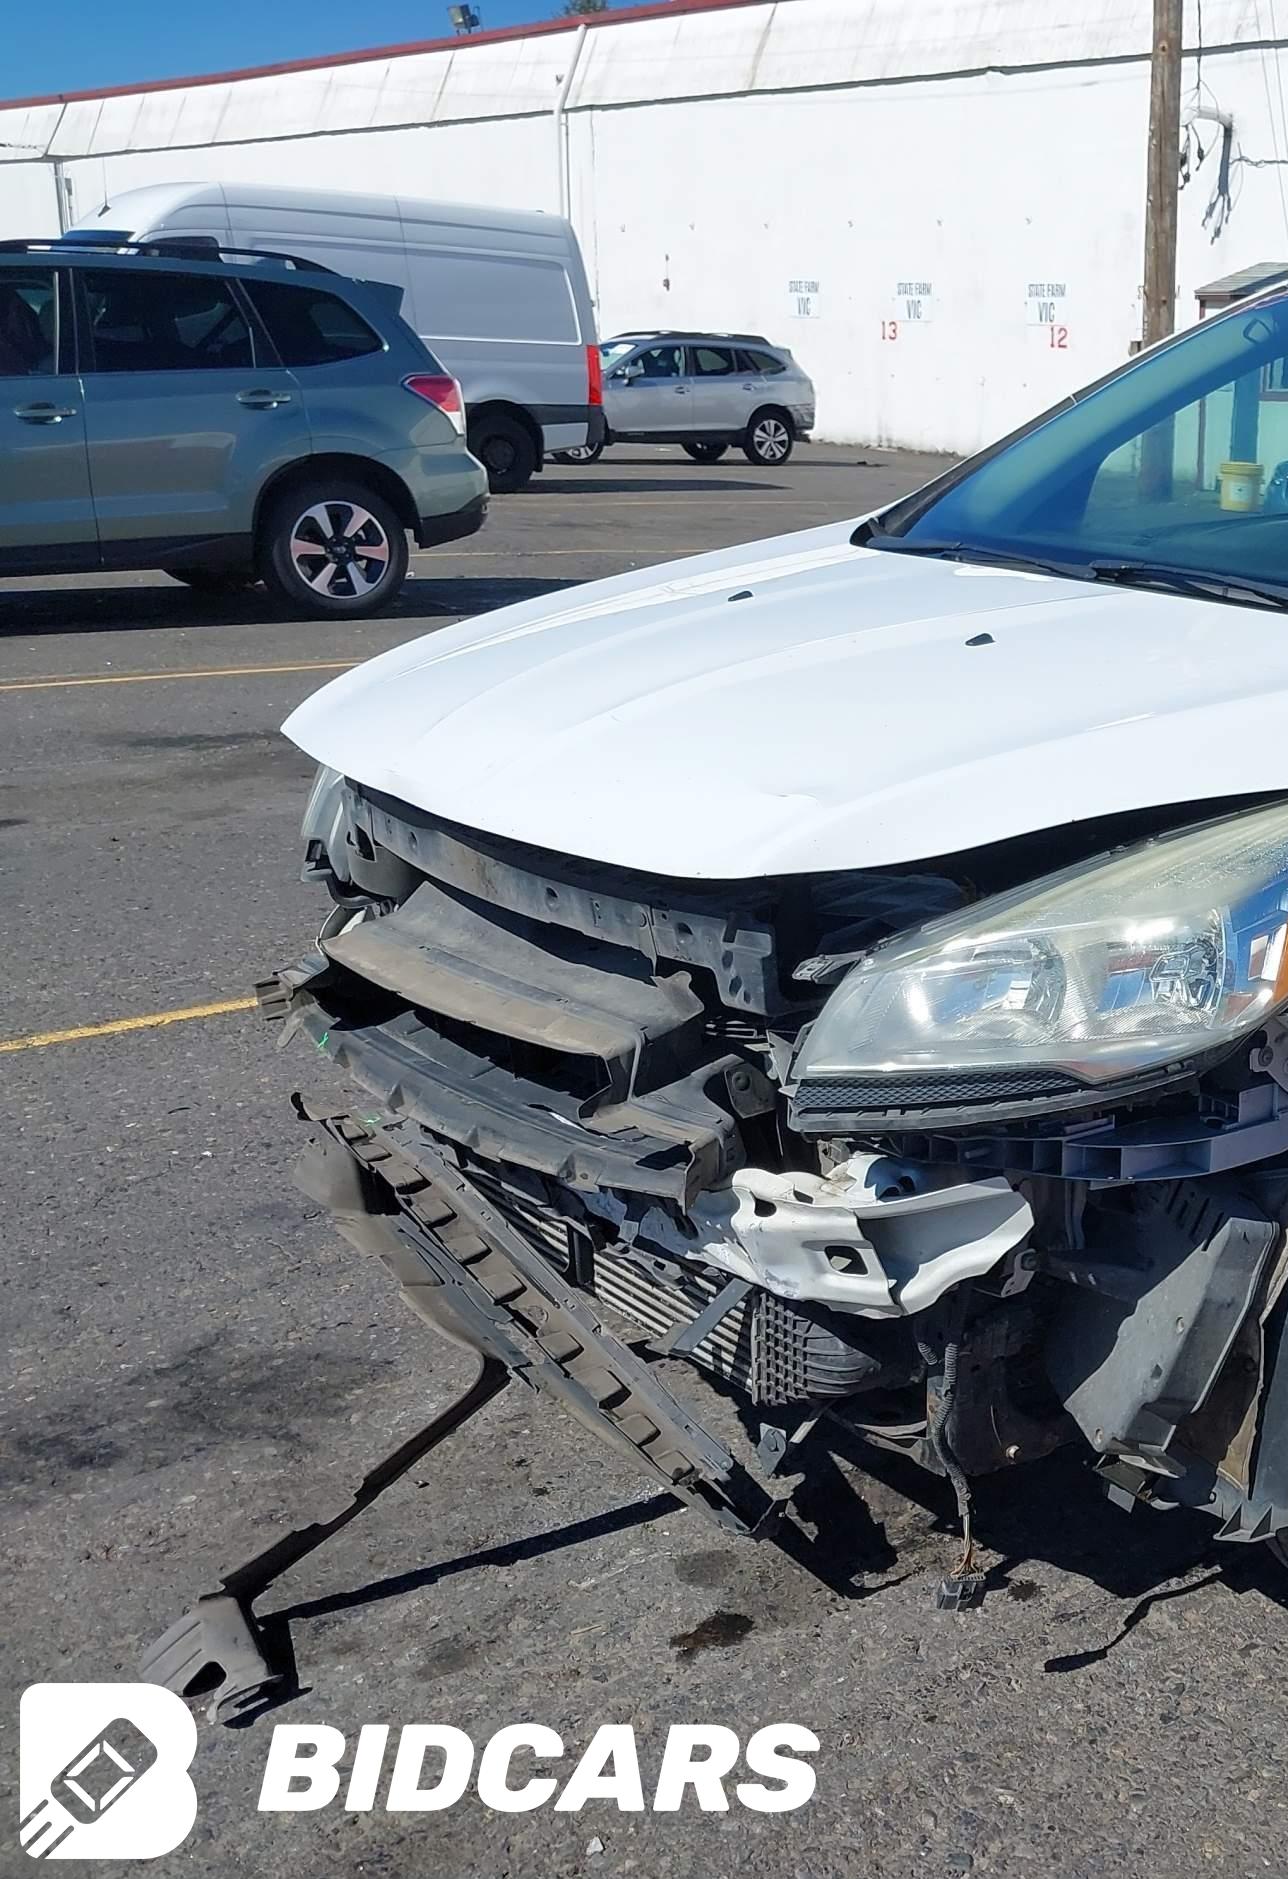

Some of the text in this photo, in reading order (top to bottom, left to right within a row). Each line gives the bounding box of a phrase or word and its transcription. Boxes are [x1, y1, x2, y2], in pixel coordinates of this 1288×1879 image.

[897, 282, 913, 295] STATE
[1028, 283, 1045, 297] STATE
[906, 299, 922, 319] VIC
[1038, 302, 1055, 322] VIC
[881, 320, 898, 341] 13
[1050, 326, 1068, 348] 12
